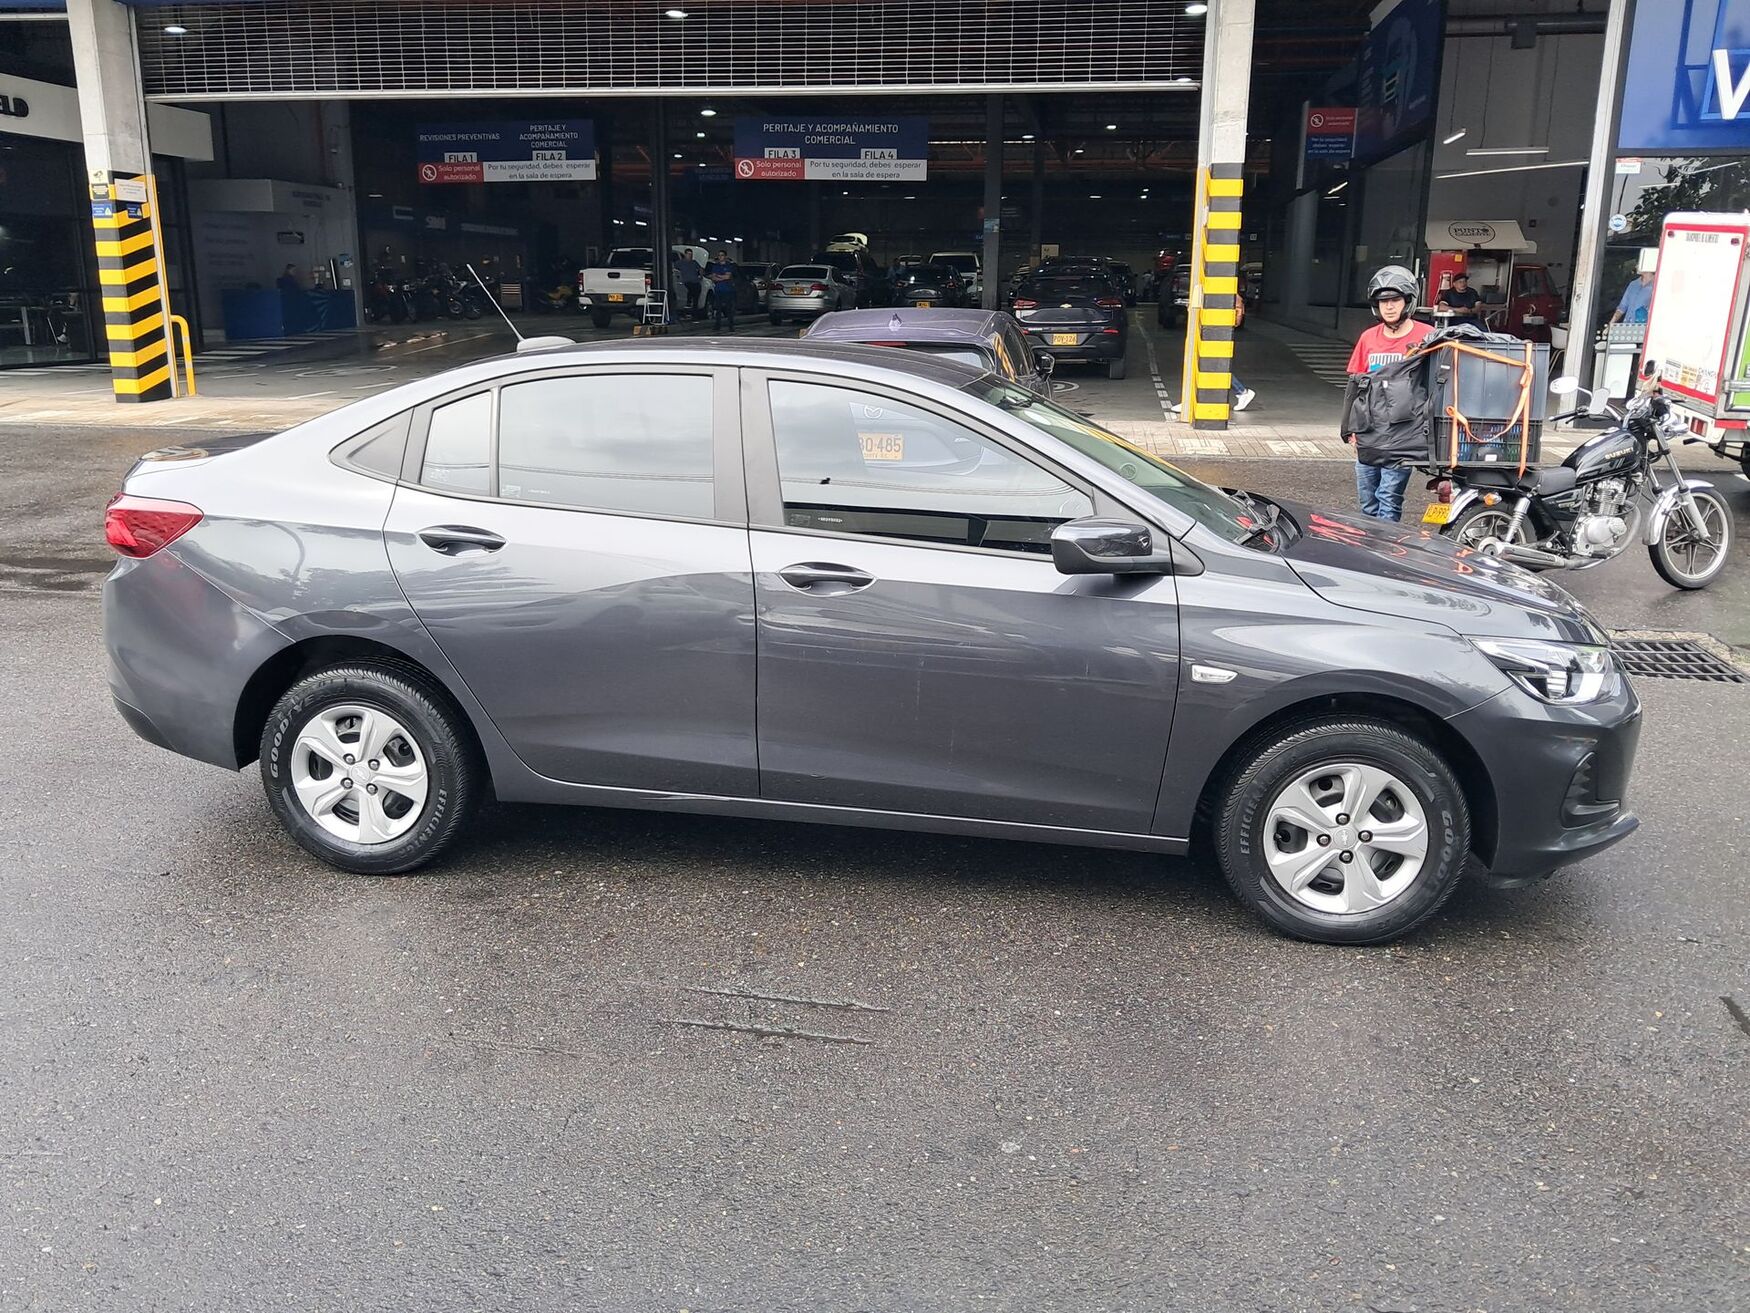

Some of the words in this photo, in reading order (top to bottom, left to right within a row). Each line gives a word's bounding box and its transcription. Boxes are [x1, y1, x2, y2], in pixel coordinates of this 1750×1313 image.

[0, 95, 28, 118] LD
[764, 124, 806, 132] PERITAJE
[808, 124, 814, 132] Y
[816, 122, 898, 133] ACOMPAÑAMIENTO
[805, 136, 856, 144] COMERCIAL
[772, 161, 802, 169] personal
[1604, 447, 1633, 459] SUZUKI
